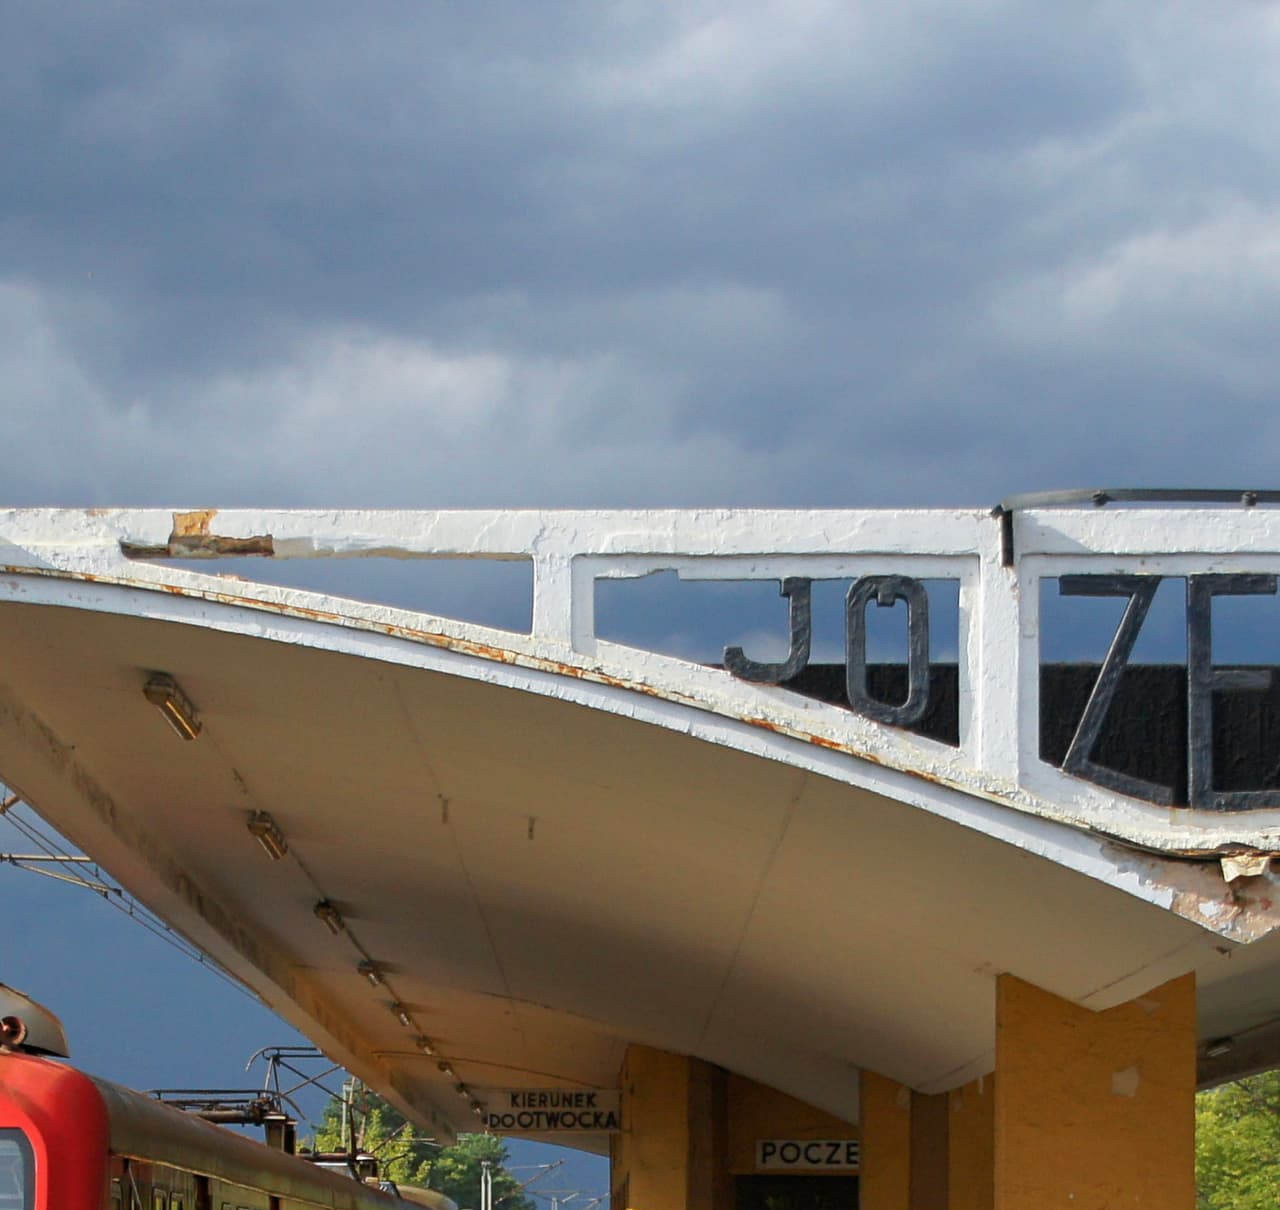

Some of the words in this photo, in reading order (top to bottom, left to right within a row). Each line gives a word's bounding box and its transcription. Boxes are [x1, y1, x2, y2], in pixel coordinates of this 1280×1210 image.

[511, 1091, 597, 1108] KIERUNEK
[489, 1113, 516, 1129] DO
[517, 1111, 618, 1129] OTWOCKA
[761, 1142, 859, 1165] POCZE
